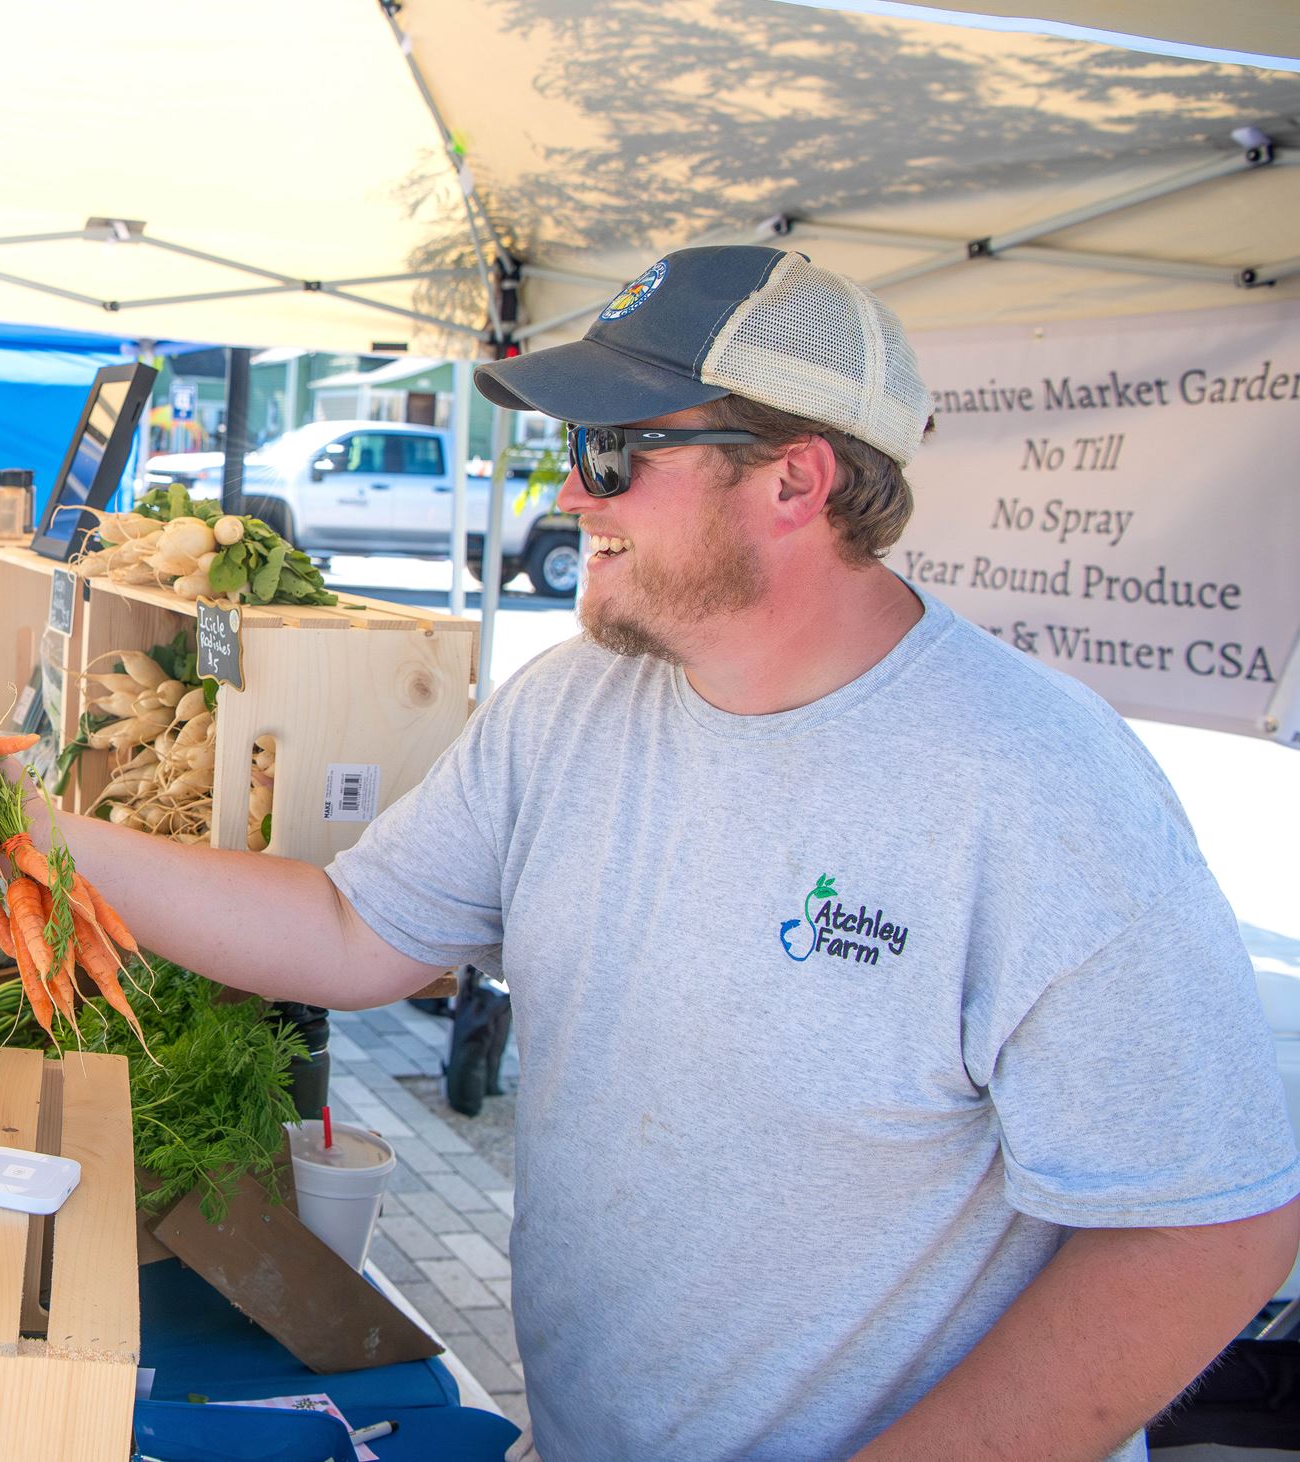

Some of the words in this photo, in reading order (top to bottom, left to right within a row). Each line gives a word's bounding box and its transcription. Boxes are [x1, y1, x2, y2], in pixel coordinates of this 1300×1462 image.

[931, 378, 1034, 413] enative
[1043, 370, 1170, 411] Market
[1021, 437, 1065, 471] No
[1072, 433, 1125, 472] Till
[991, 498, 1035, 530] No
[1041, 499, 1135, 547] Spray
[905, 551, 964, 586] Year
[970, 556, 1071, 597] Round
[1083, 564, 1242, 611] Produce
[199, 606, 226, 638] Icicle
[208, 648, 220, 673] $5
[1012, 620, 1039, 654] &
[1045, 624, 1174, 672] Winter
[1185, 640, 1277, 684] CSA
[324, 800, 332, 819] MAKE
[814, 900, 909, 955] Atchley
[815, 927, 880, 965] Farm
